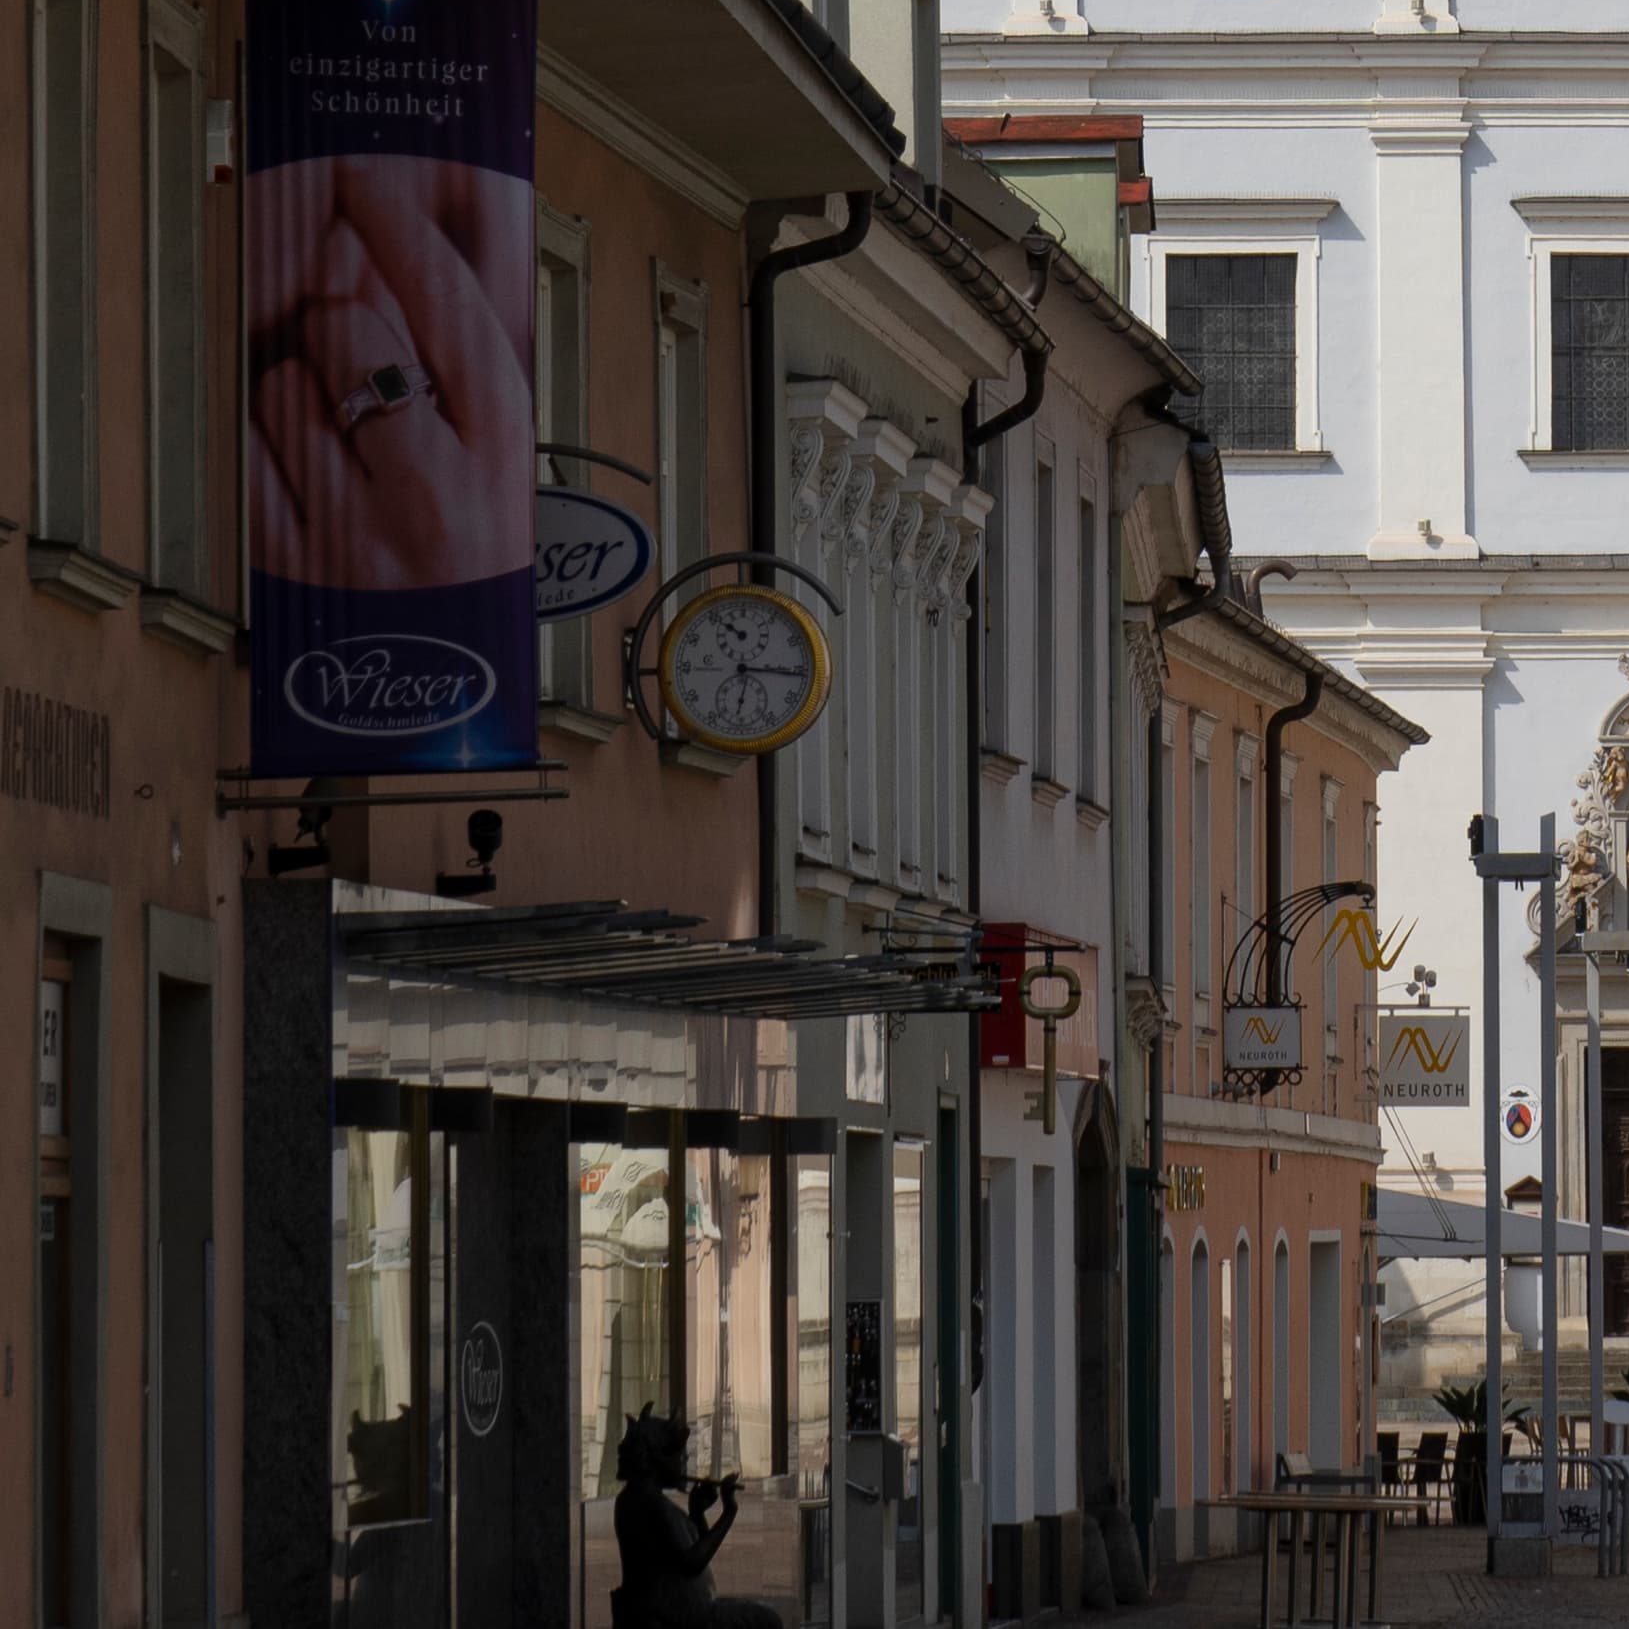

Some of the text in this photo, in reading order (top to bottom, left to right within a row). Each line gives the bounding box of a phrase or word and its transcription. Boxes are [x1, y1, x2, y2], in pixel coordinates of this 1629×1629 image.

[360, 19, 417, 42] Von
[288, 53, 489, 85] einzigartiger
[311, 88, 465, 118] Schönheit
[316, 649, 477, 709] Wieser
[1239, 1051, 1287, 1060] NEUROTH
[1383, 1084, 1465, 1097] NEUROTH
